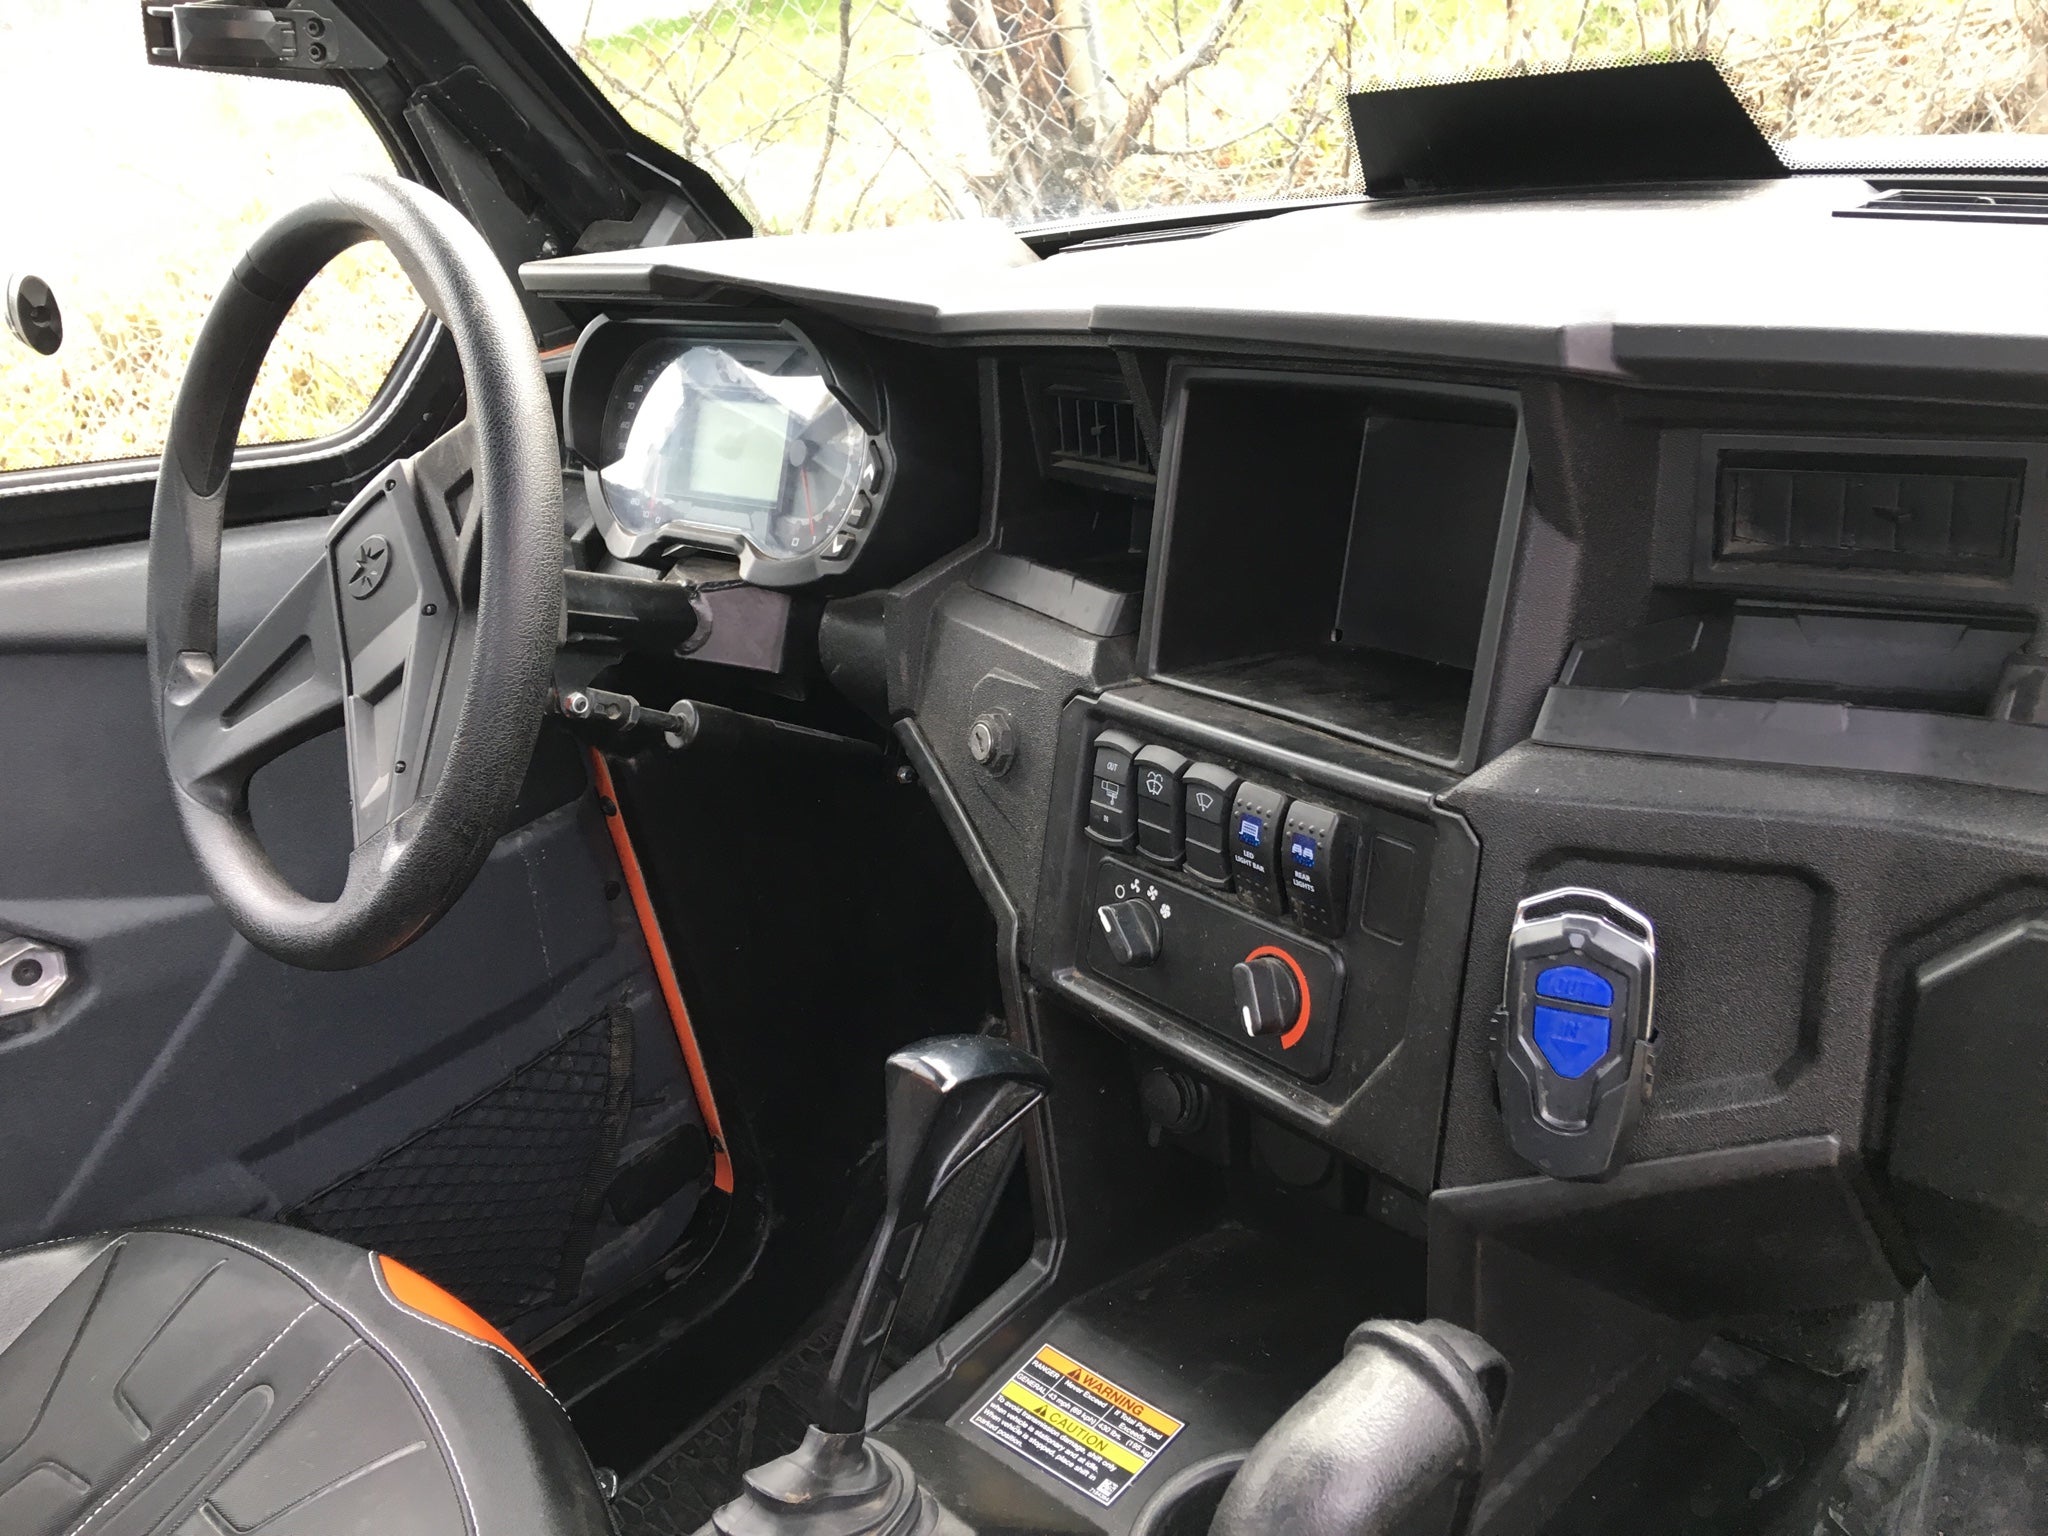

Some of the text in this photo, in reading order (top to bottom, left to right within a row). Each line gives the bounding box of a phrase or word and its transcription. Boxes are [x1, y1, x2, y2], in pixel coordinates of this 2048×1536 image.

[1106, 762, 1118, 772] OUT
[1103, 814, 1110, 823] IN
[1234, 855, 1265, 873] LIGHT BAR
[1242, 849, 1255, 860] LED
[1292, 878, 1316, 893] LIGHTS
[1294, 870, 1311, 882] REAR
[1016, 1372, 1047, 1395] GENERAL
[1031, 1359, 1061, 1380] RANGER
[1064, 1379, 1108, 1408] Never Exceed
[1083, 1375, 1144, 1416] WARNING
[1048, 1392, 1056, 1400] 43
[1056, 1396, 1071, 1411] mph
[1081, 1411, 1097, 1425] kph)
[975, 1416, 1023, 1448] parked position.
[990, 1402, 1007, 1415] when
[1006, 1411, 1029, 1429] vehicle
[1034, 1428, 1066, 1454] stationary
[1065, 1449, 1079, 1462] and
[1078, 1456, 1087, 1465] at
[997, 1394, 1118, 1473] To avoid transmission damage, shift only
[1049, 1412, 1109, 1452] CAUTION
[1118, 1422, 1147, 1442] Exceeds
[1120, 1412, 1137, 1426] Total
[1137, 1422, 1163, 1440] Payload
[983, 1408, 1002, 1424] When
[1001, 1418, 1023, 1436] vehicle
[1028, 1435, 1056, 1458] stopped,
[1055, 1454, 1075, 1468] place
[1073, 1465, 1089, 1479] shift
[1088, 1473, 1097, 1481] in
[1110, 1429, 1122, 1441] lbs.
[1141, 1447, 1154, 1459] kg)
